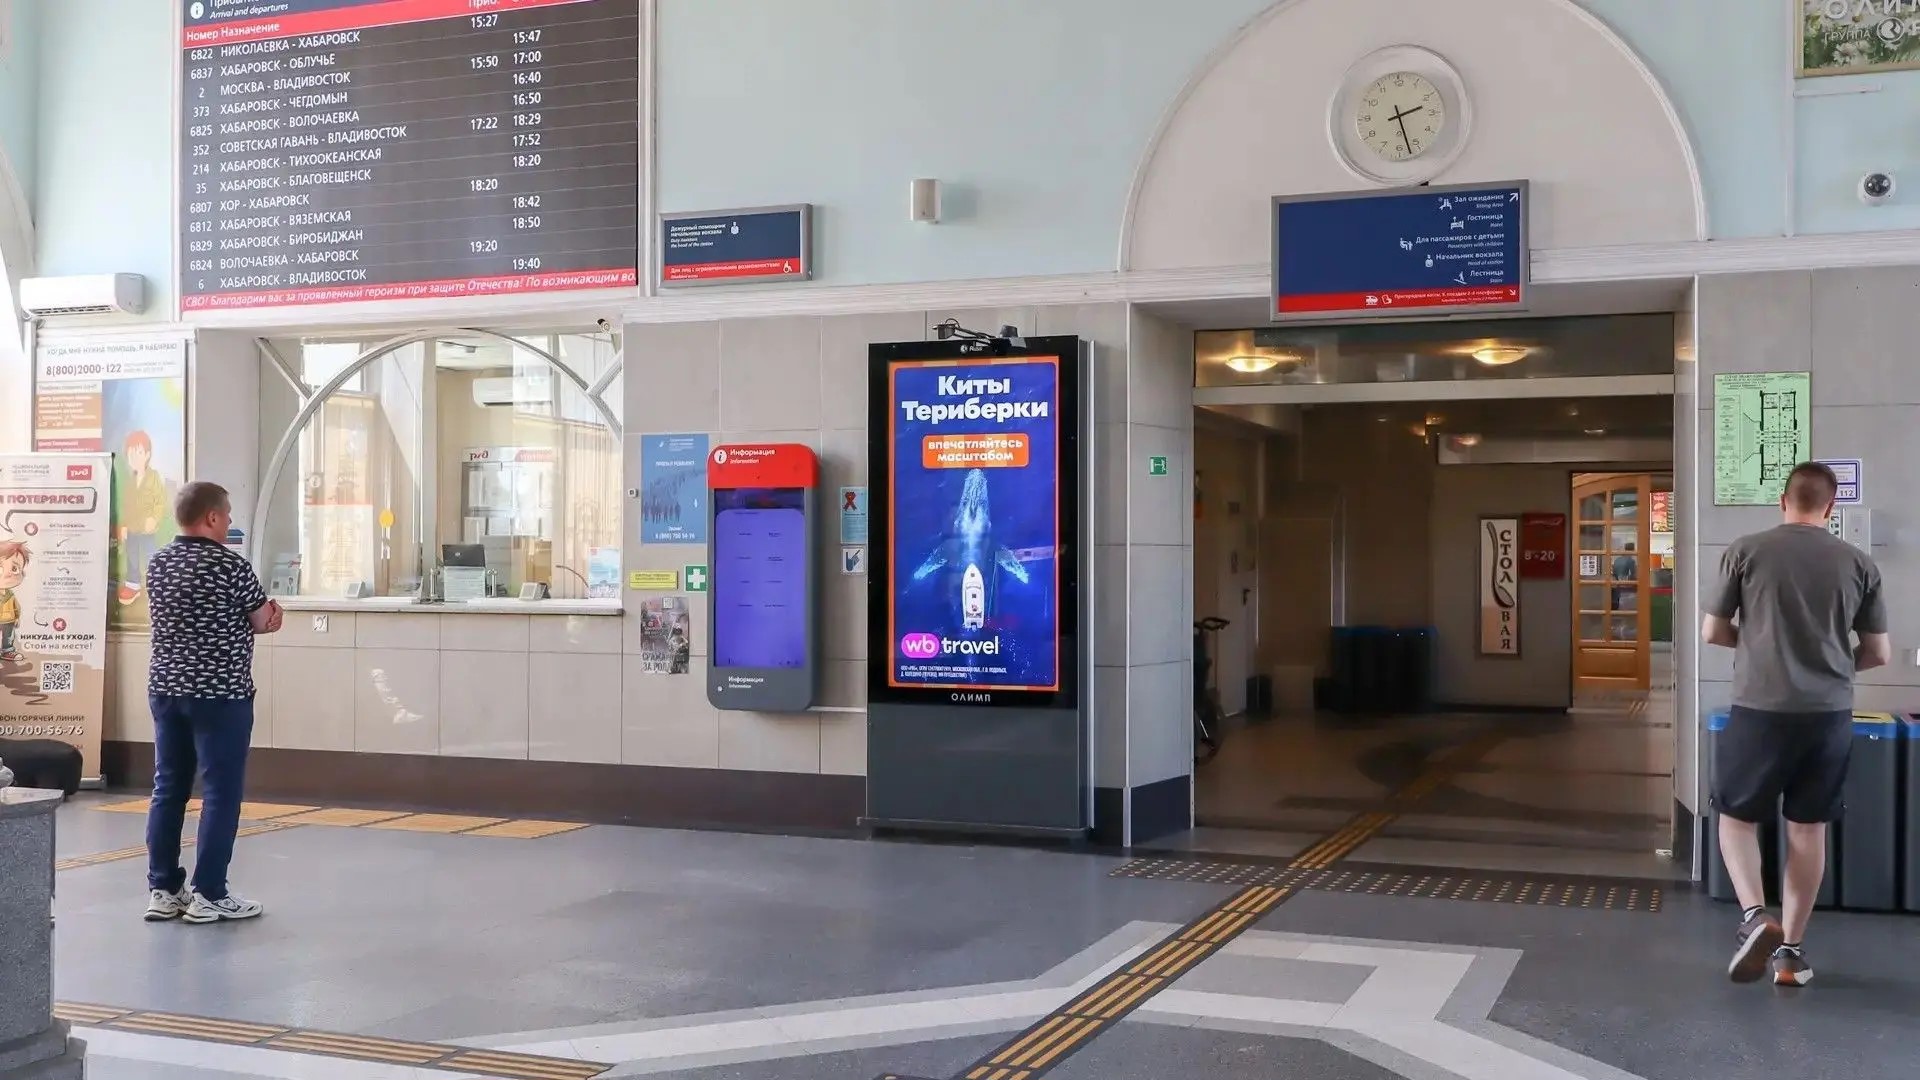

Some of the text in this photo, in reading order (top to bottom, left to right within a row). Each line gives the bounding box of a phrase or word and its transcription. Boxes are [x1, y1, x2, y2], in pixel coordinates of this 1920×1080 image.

[210, 4, 288, 19] Arrival and departures
[187, 30, 218, 41] Номер
[221, 23, 280, 37] Назначение
[191, 14, 498, 60] 6822 НИКОЛАЕВКА ХАБАРОВСК 15:27
[191, 30, 541, 80] 6837 ХАБАРОВСК ОБЛУЧЬЕ 15:47
[199, 51, 541, 98] 2 МОСКВА ВЛАДИВОСТОК 15:50 17:00
[193, 72, 541, 118] 373 ХАБАРОВСК ЧЕГДОМЫН 16:40
[190, 92, 541, 137] 6825 ХАБАРОВСК ВОЛОЧАЕВКА 16:50
[193, 113, 541, 156] 352 СОВЕТСКАЯ ГАВАНЬ ВЛАДИВОСТОК 17:22 18:29
[193, 134, 541, 176] 214 ХАБАРОВСК ТИХООКЕАНСКАЯ 17:52
[196, 154, 541, 193] 35 ХАБАРОВСК БЛАГОВЕЩЕНСК 18:20
[190, 178, 498, 213] 6807 ХОР ХАБАРОВСК 18:20
[190, 196, 540, 232] 6812 ХАБАРОВСК ВЯЗЕМСКАЯ 18:42
[190, 216, 540, 251] 6829 ХАБАРОВСК БИРОБИДЖАН 18:50
[190, 240, 497, 270] 6824 ВОЛОЧАЕВКА ХАБАРОВСК 19:20
[199, 258, 540, 290] 6 ХАБАРОВСК ВЛАДИВОСТОК 19:40
[211, 296, 266, 305] Благодарим
[268, 294, 284, 303] вас
[298, 288, 362, 301] проявленный
[365, 288, 406, 299] героизм
[408, 286, 427, 296] при
[429, 283, 465, 294] защите
[468, 278, 522, 290] Отечества!
[526, 277, 540, 287] По
[543, 274, 618, 286] возникающим
[938, 375, 1010, 396] Киты
[902, 398, 1048, 424] Териберки
[928, 438, 1023, 450] впечатляйтесь
[937, 451, 1014, 462] масштабом
[7, 495, 84, 504] ПОТЕРЯЛСЯ
[24, 641, 48, 650] Стой
[906, 636, 999, 654] wb travel
[951, 693, 991, 702] ОЛИМП
